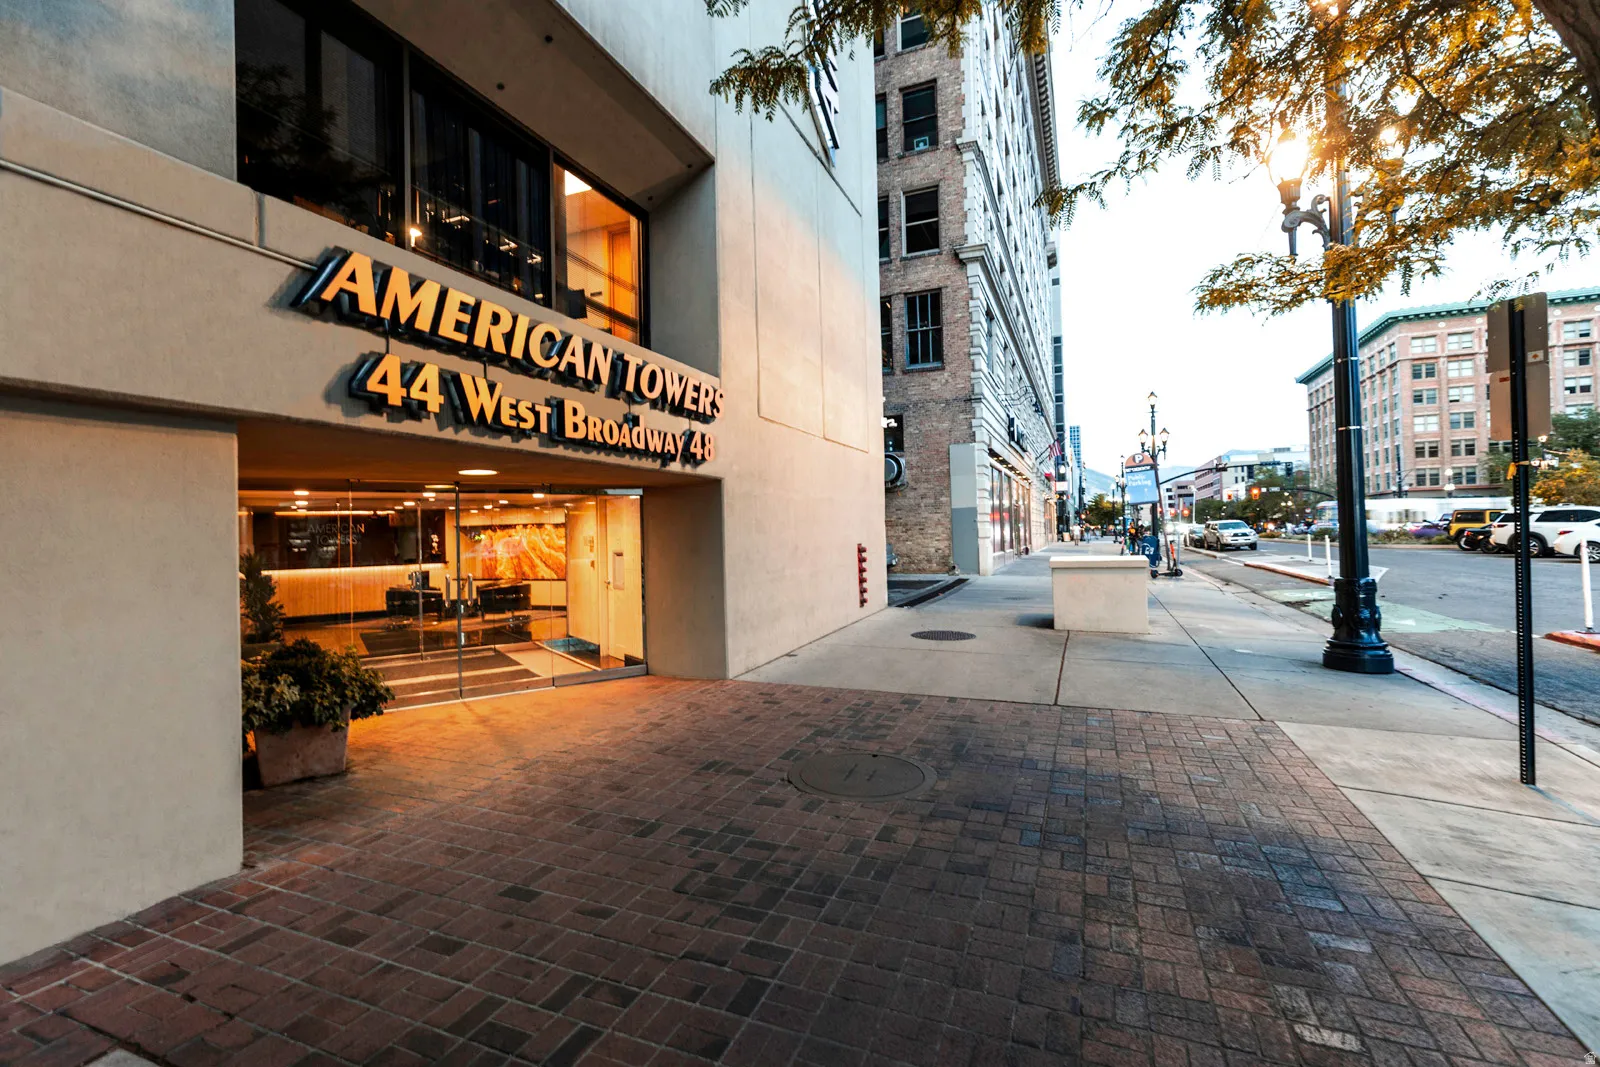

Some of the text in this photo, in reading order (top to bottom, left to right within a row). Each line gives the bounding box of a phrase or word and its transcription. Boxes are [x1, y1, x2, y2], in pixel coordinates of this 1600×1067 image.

[321, 251, 725, 419] AMERICAN TOWERS
[366, 353, 445, 413] 44
[458, 372, 552, 434] WEST
[690, 431, 716, 462] 48
[1134, 454, 1144, 464] P
[308, 523, 365, 534] AMERCAN
